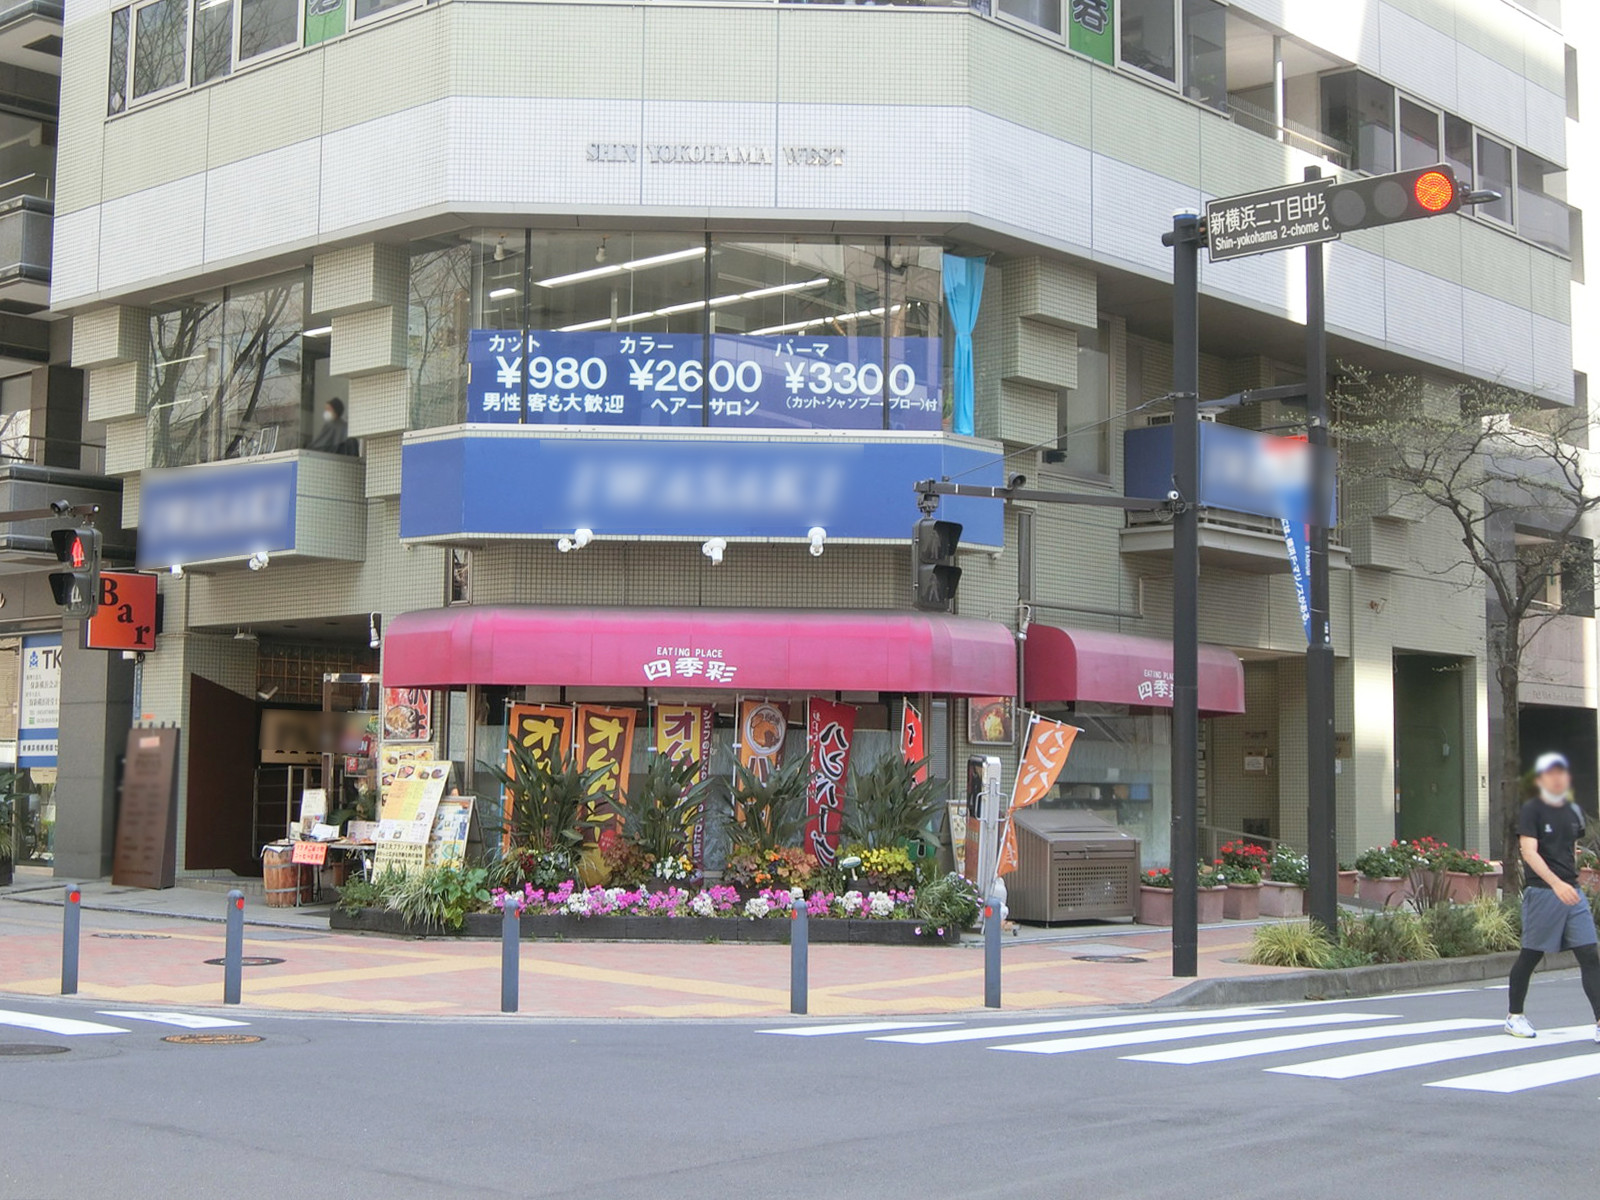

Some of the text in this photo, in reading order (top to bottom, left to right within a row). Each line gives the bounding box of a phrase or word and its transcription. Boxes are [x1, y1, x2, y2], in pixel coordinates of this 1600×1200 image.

[587, 143, 844, 166] SHIN YOKOHAMA WEST
[1215, 216, 1332, 251] Shin-yokohama 2-chome C
[488, 335, 541, 353] カット
[619, 336, 674, 354] カラー
[775, 339, 830, 357] パーマ
[496, 356, 608, 390] ¥980
[628, 359, 763, 393] ¥2600
[785, 361, 916, 396] ¥3300
[100, 578, 151, 645] Bar
[656, 646, 723, 658] EATING PLACE
[643, 657, 738, 683] 四季彩
[1144, 669, 1162, 679] EATING
